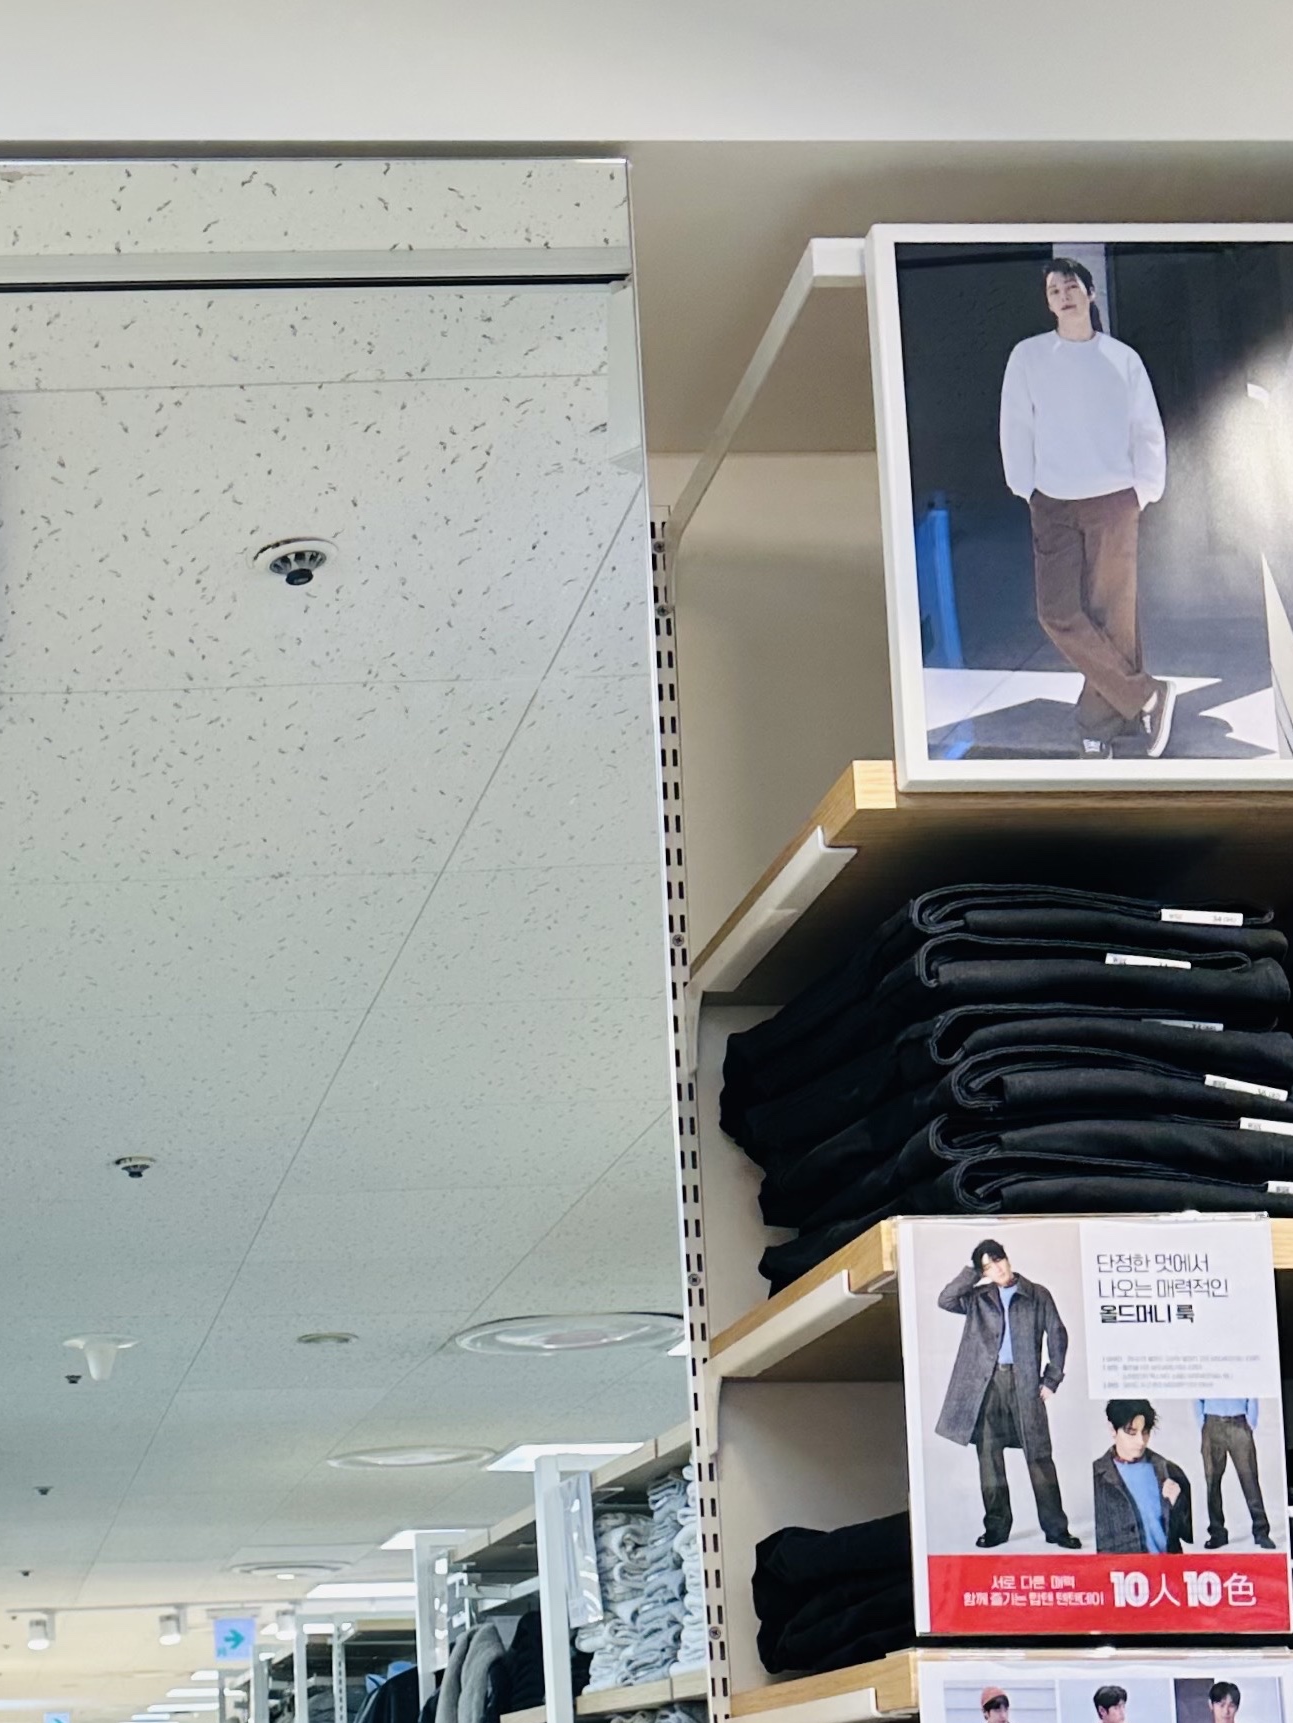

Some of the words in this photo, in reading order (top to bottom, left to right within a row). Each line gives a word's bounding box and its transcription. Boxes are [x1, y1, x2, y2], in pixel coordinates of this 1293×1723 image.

[1096, 1253, 1150, 1273] 단정한
[1154, 1253, 1209, 1273] 멋에서
[1097, 1279, 1153, 1298] 나오는
[1156, 1278, 1229, 1298] 매력적인
[1099, 1304, 1172, 1324] 올드머니
[1176, 1304, 1195, 1324] 룩
[991, 1575, 1016, 1590] 서로
[1020, 1575, 1046, 1590] 다른
[963, 1592, 989, 1607] 함께
